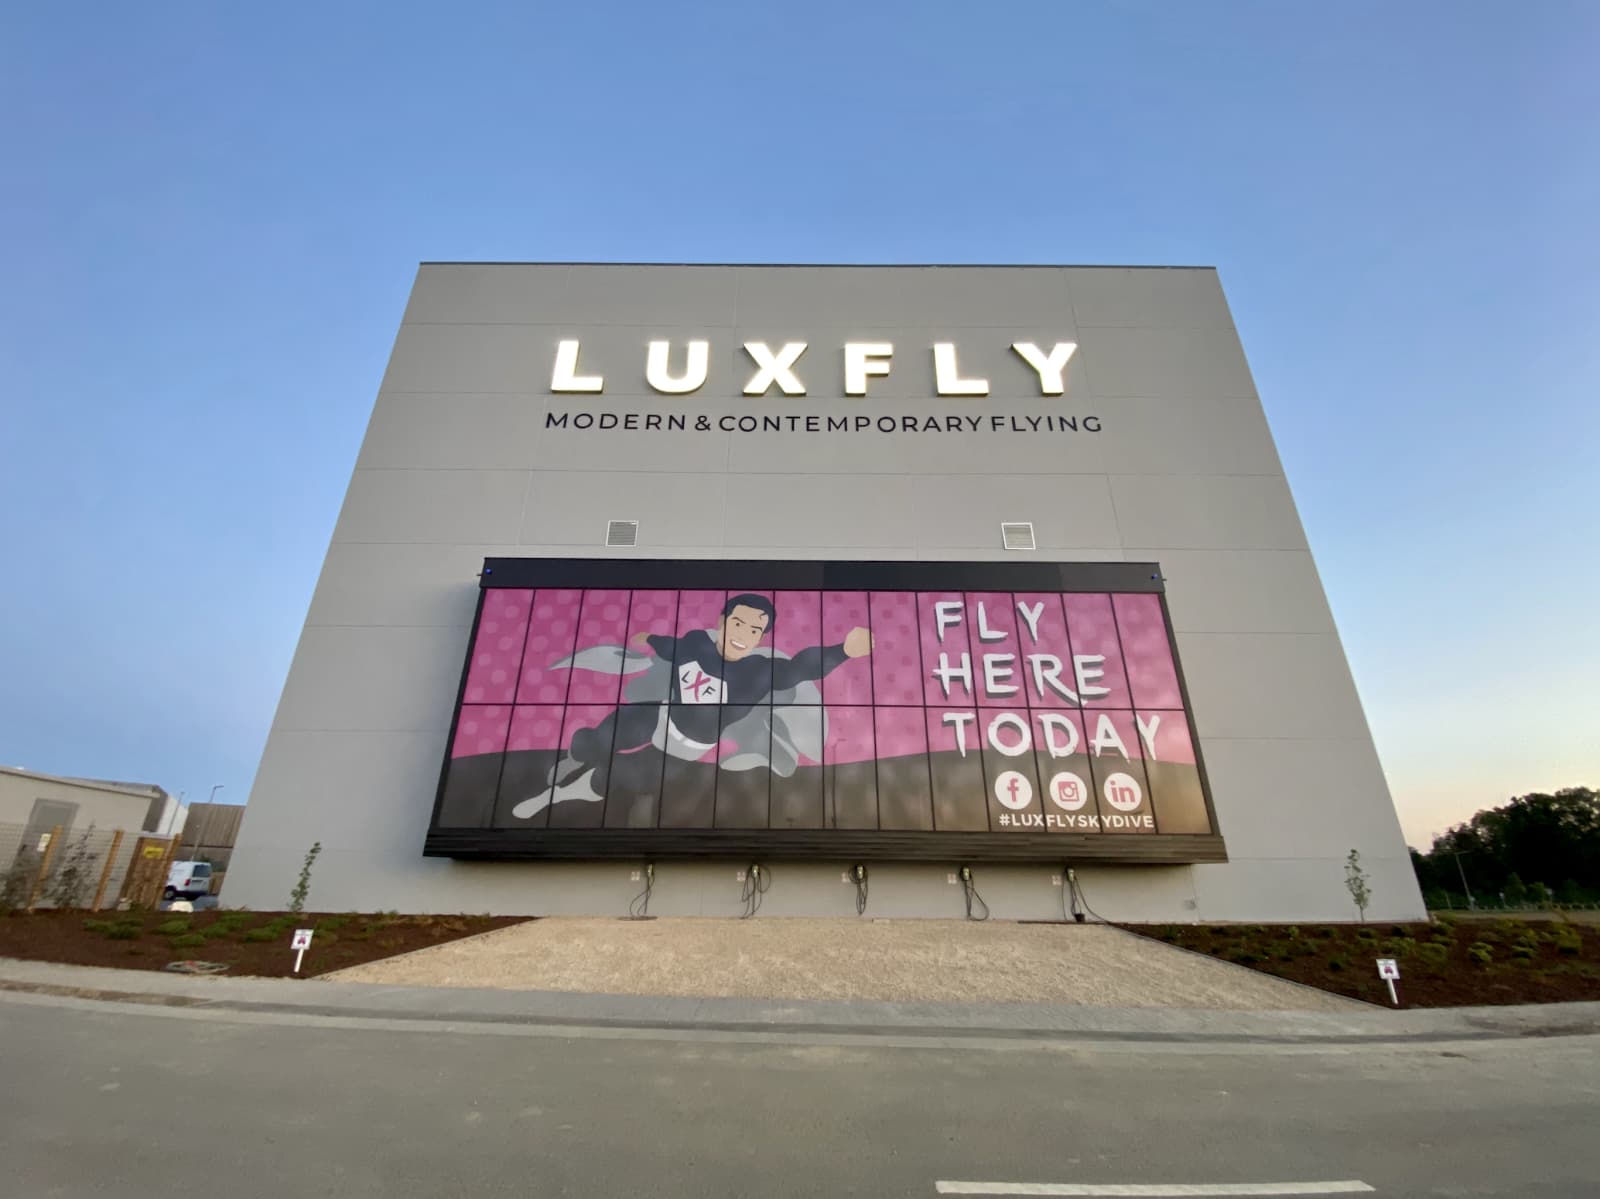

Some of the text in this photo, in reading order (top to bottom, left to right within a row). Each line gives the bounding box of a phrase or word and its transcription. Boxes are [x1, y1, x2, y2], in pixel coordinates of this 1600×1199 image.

[551, 340, 1078, 397] LUXFLY
[545, 412, 1102, 433] MODERN & CONTEMPORARY FLYING
[935, 601, 1045, 644] FLY
[932, 652, 1111, 706] HERE
[942, 712, 1160, 763] TODAY
[999, 813, 1155, 829] #LUXFLYSKYDIVE
